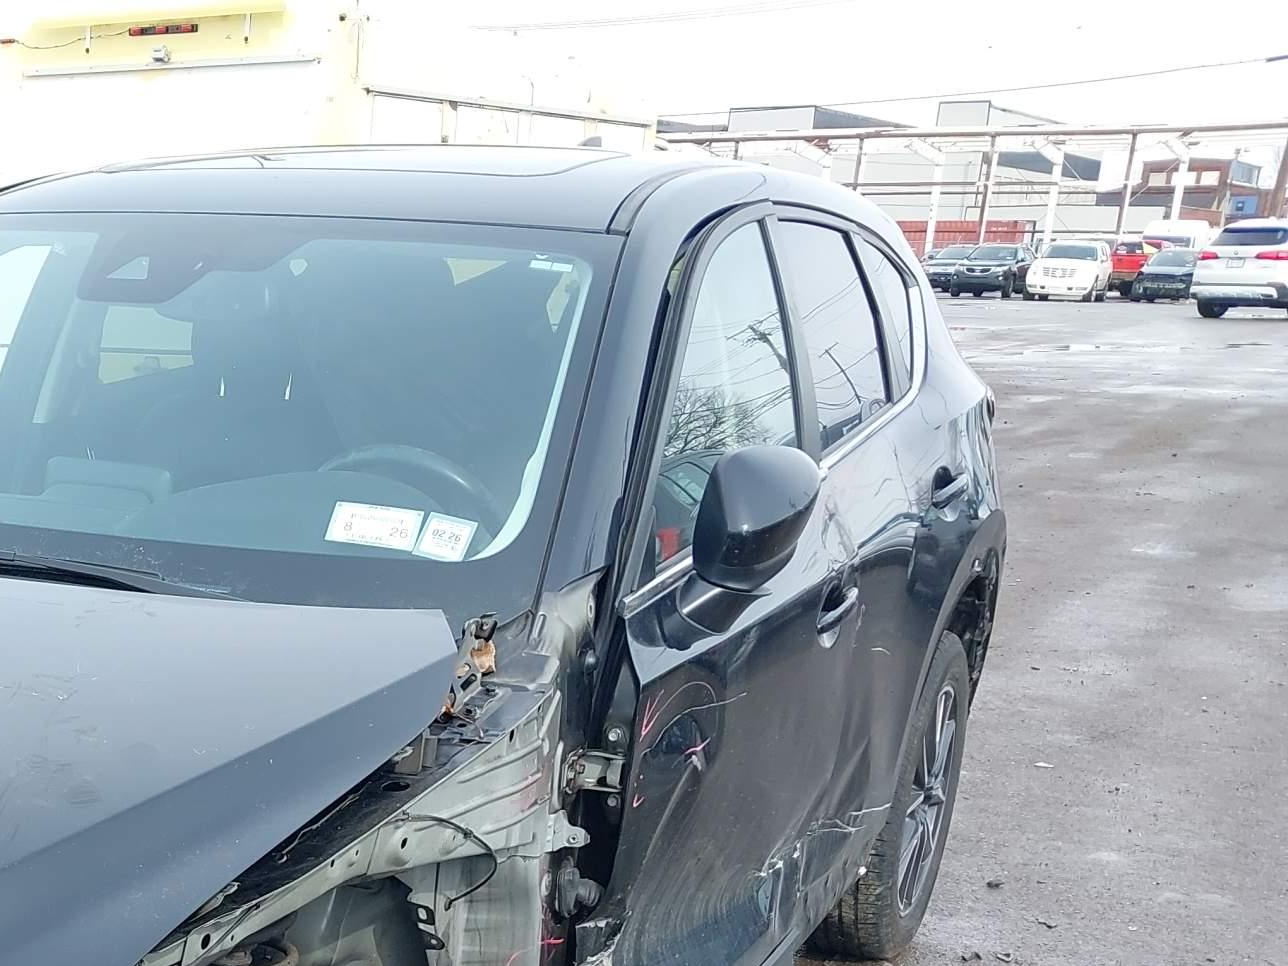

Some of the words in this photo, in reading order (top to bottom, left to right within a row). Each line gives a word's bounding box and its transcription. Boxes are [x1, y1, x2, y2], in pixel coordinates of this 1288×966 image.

[389, 526, 409, 540] 26
[431, 528, 447, 538] 02
[447, 531, 463, 543] 26
